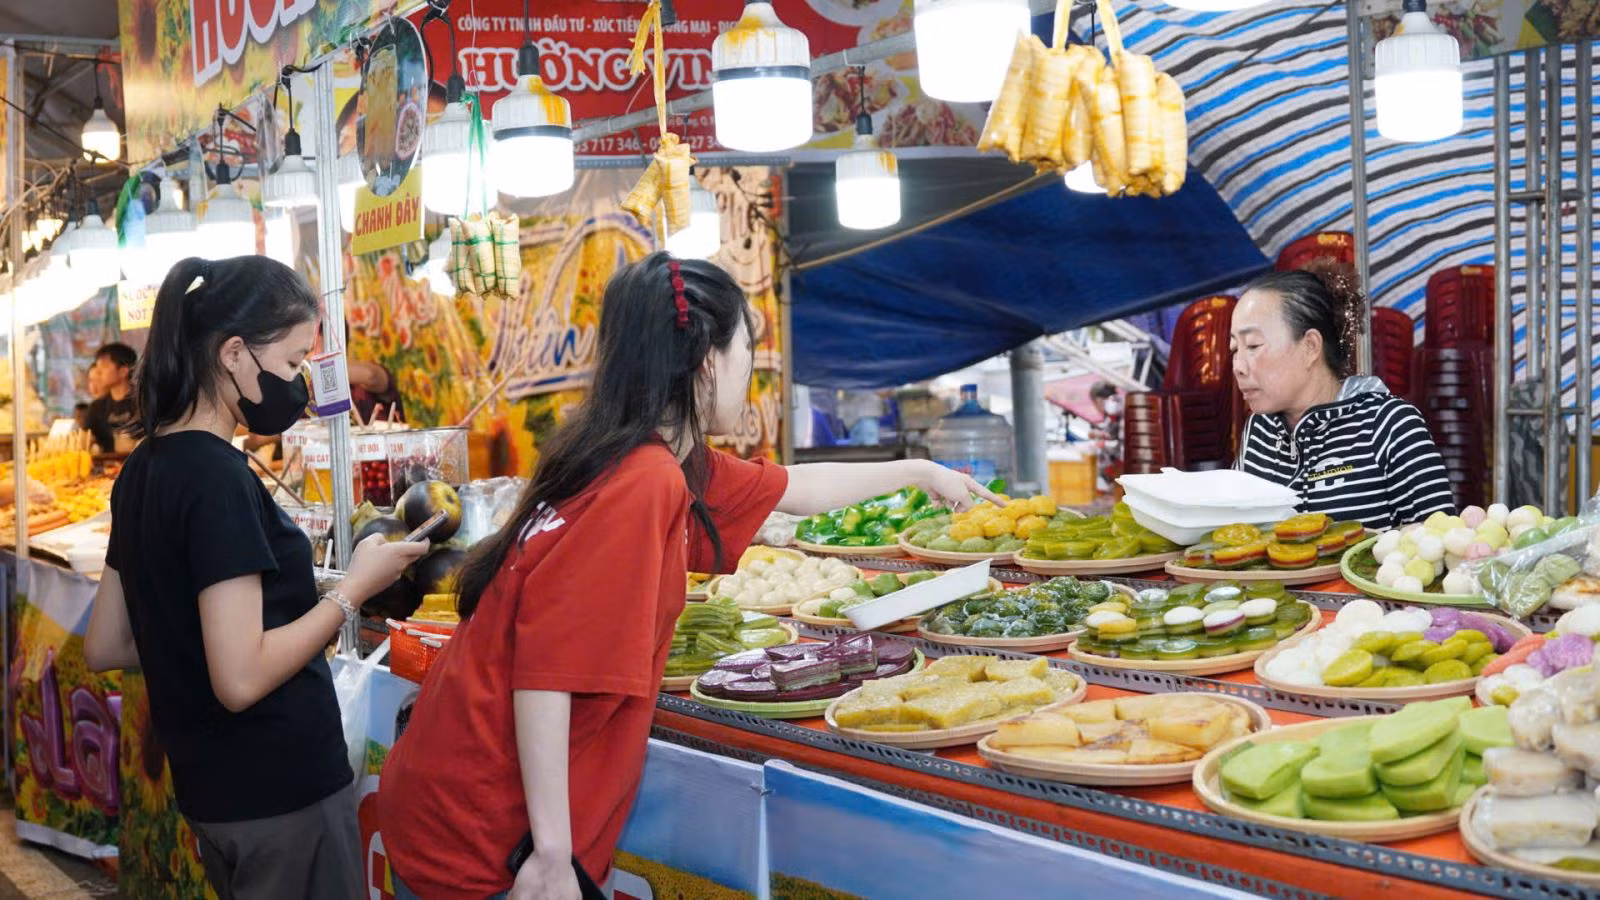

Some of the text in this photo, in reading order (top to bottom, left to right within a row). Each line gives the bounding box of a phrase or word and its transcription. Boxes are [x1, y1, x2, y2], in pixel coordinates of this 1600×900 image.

[457, 14, 490, 32] CÔNG
[491, 17, 507, 32] TY
[593, 15, 615, 32] XÚC
[690, 20, 711, 38] MẠI
[592, 137, 613, 151] 717
[617, 137, 640, 151] 346
